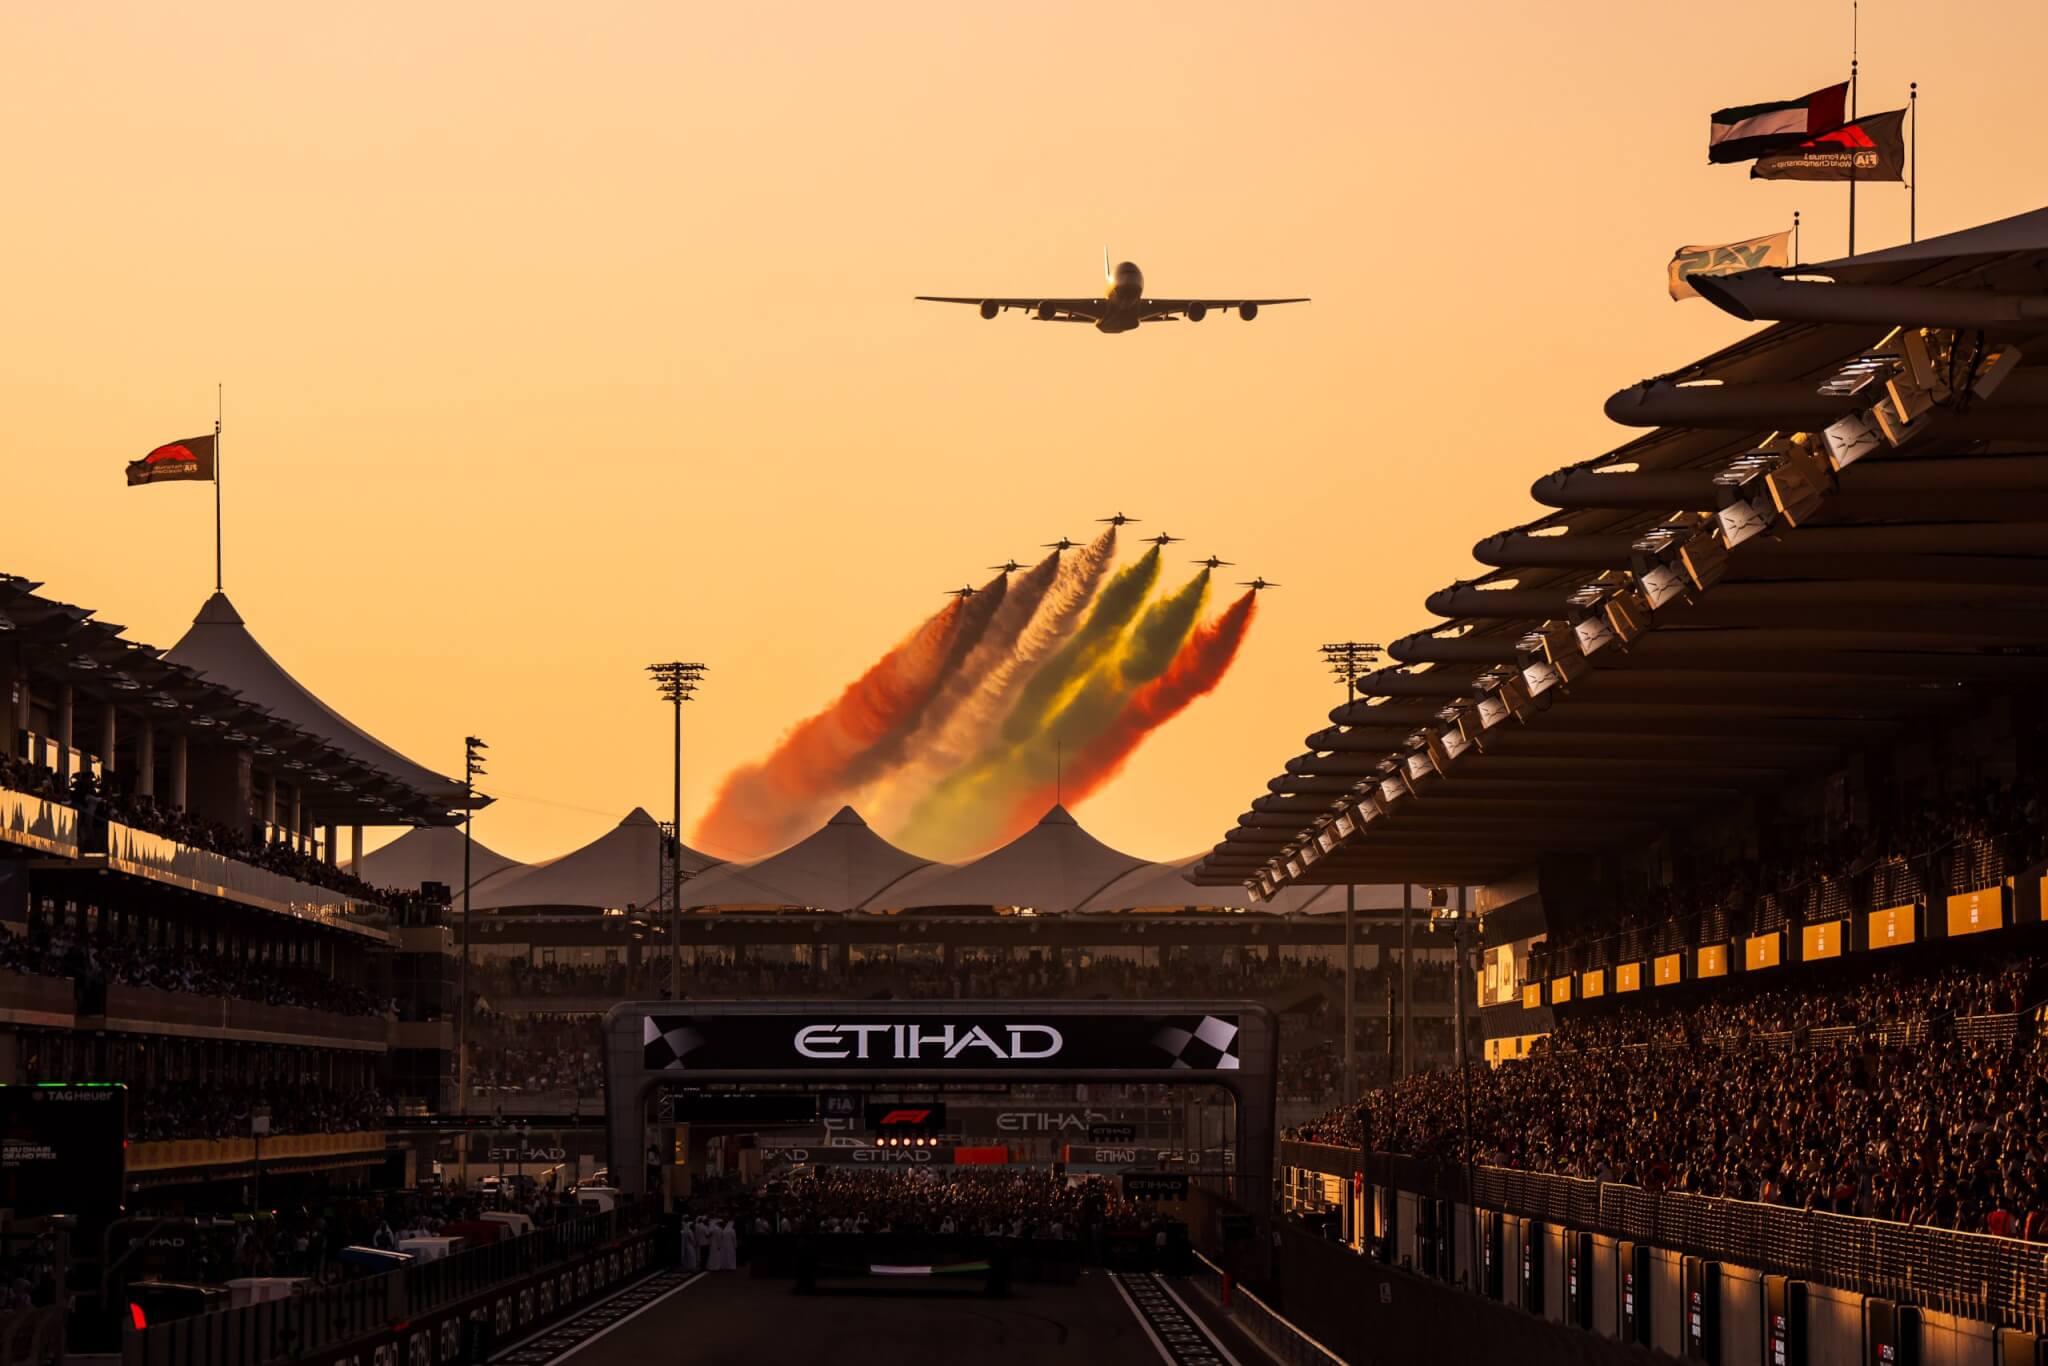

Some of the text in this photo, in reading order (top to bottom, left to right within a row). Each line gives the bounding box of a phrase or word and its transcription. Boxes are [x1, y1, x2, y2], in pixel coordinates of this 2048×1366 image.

[792, 1023, 1064, 1060] ETIHAD
[852, 1149, 932, 1162] ETIHAD
[1095, 1150, 1136, 1163] ETIHAD
